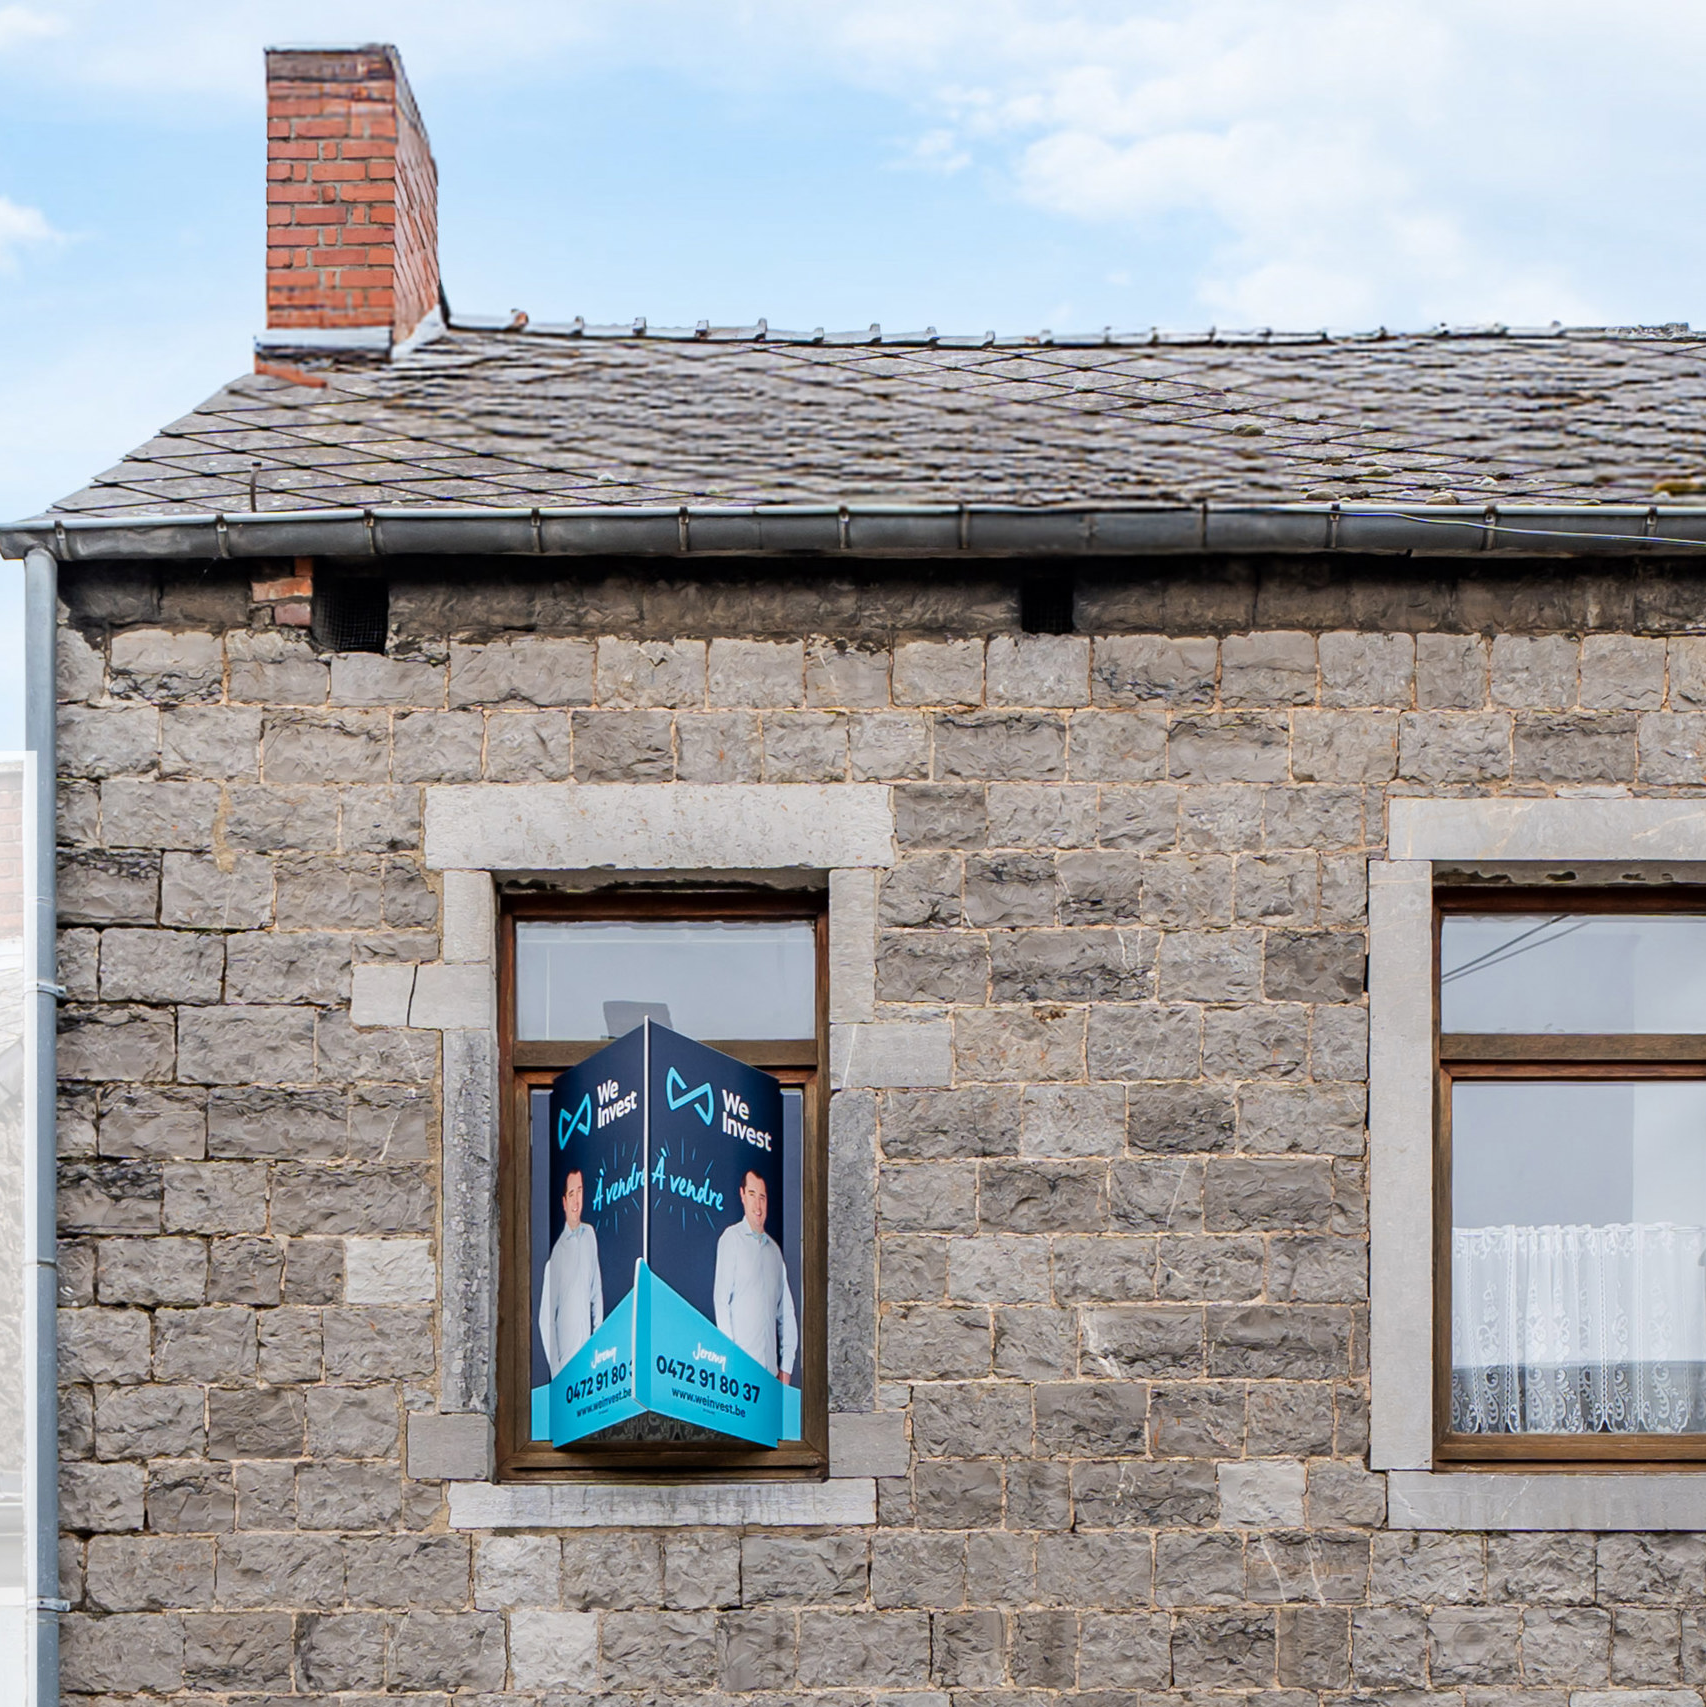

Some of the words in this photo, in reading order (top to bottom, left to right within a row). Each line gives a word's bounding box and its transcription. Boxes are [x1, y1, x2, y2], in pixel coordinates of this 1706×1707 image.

[597, 1079, 619, 1106] We
[597, 1090, 638, 1129] Invest
[722, 1089, 750, 1120] We
[722, 1111, 772, 1152] Invest
[593, 1168, 605, 1212] À
[651, 1147, 666, 1191] À
[670, 1174, 724, 1211] vendre
[692, 1342, 727, 1373] Jeremy
[566, 1376, 594, 1404] 0472
[596, 1369, 609, 1391] 91
[611, 1362, 627, 1385] 80
[656, 1355, 696, 1384] 0472
[699, 1368, 716, 1390] 91
[720, 1375, 739, 1397] 80
[743, 1383, 760, 1404] 37
[671, 1387, 746, 1418] www.weinvest.be
